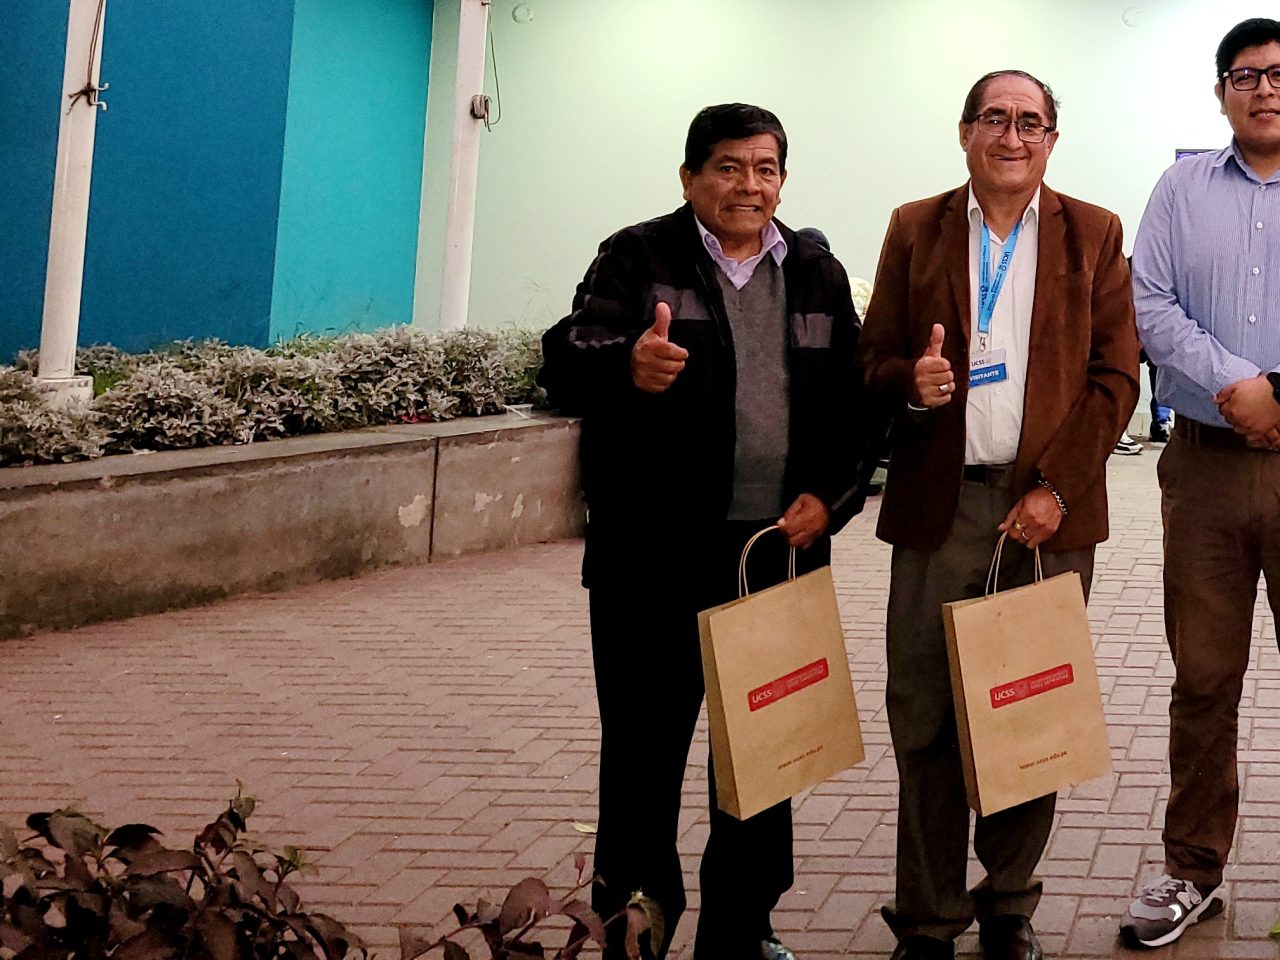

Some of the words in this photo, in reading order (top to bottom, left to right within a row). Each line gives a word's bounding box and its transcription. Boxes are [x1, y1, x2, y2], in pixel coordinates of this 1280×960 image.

[969, 369, 1000, 382] VISITANTE
[752, 689, 773, 704] UCSS
[994, 688, 1015, 701] UCSS
